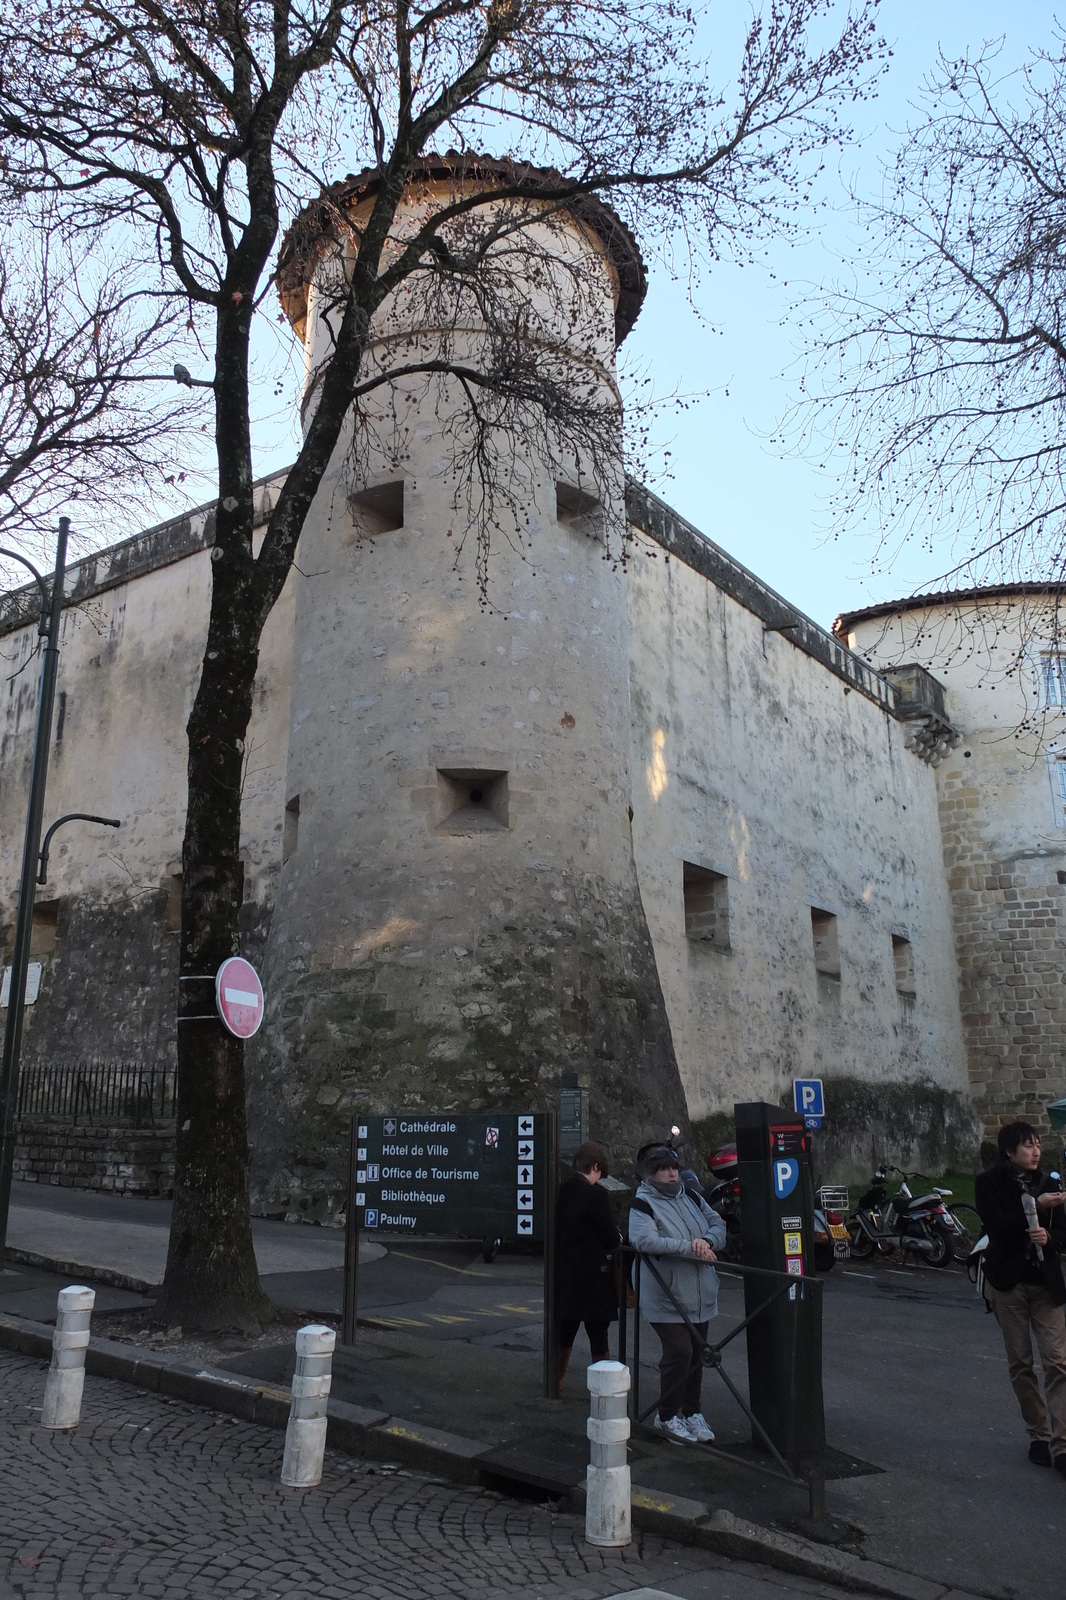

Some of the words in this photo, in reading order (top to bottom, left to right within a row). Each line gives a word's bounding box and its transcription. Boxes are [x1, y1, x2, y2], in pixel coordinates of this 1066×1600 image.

[802, 1086, 815, 1109] P
[399, 1121, 456, 1133] Cathédrale
[382, 1144, 408, 1156] Hôtel
[411, 1145, 423, 1156] de
[427, 1144, 449, 1156] Ville
[381, 1167, 412, 1179] Office
[415, 1168, 428, 1179] de
[431, 1168, 479, 1180] Tourisme
[777, 1162, 792, 1191] P
[381, 1190, 446, 1205] Bibliothèque
[368, 1212, 376, 1225] P
[380, 1213, 417, 1228] Paulmy
